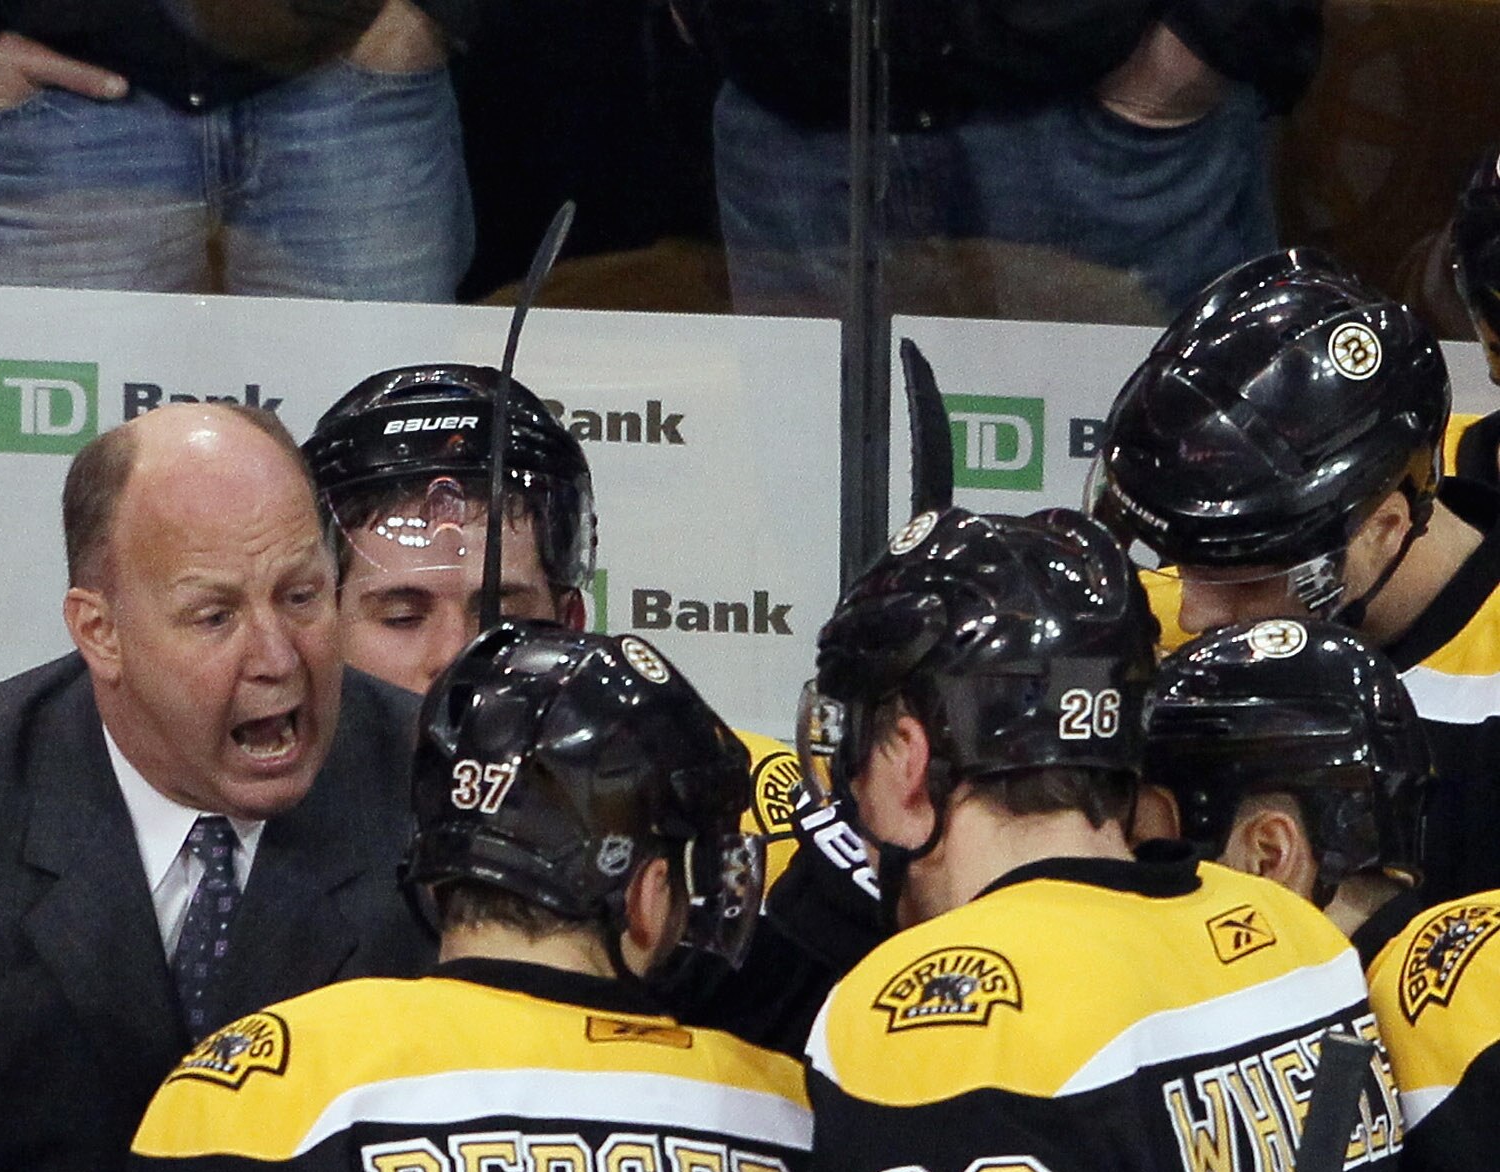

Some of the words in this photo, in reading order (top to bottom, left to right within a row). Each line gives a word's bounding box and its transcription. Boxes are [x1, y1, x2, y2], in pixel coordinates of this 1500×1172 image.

[3, 378, 88, 437] TD
[383, 414, 479, 436] BAUER
[950, 412, 1035, 470] TD
[632, 588, 794, 635] Bank
[1058, 688, 1121, 740] 26
[451, 759, 516, 815] 37
[890, 955, 1008, 1000] BRUINS
